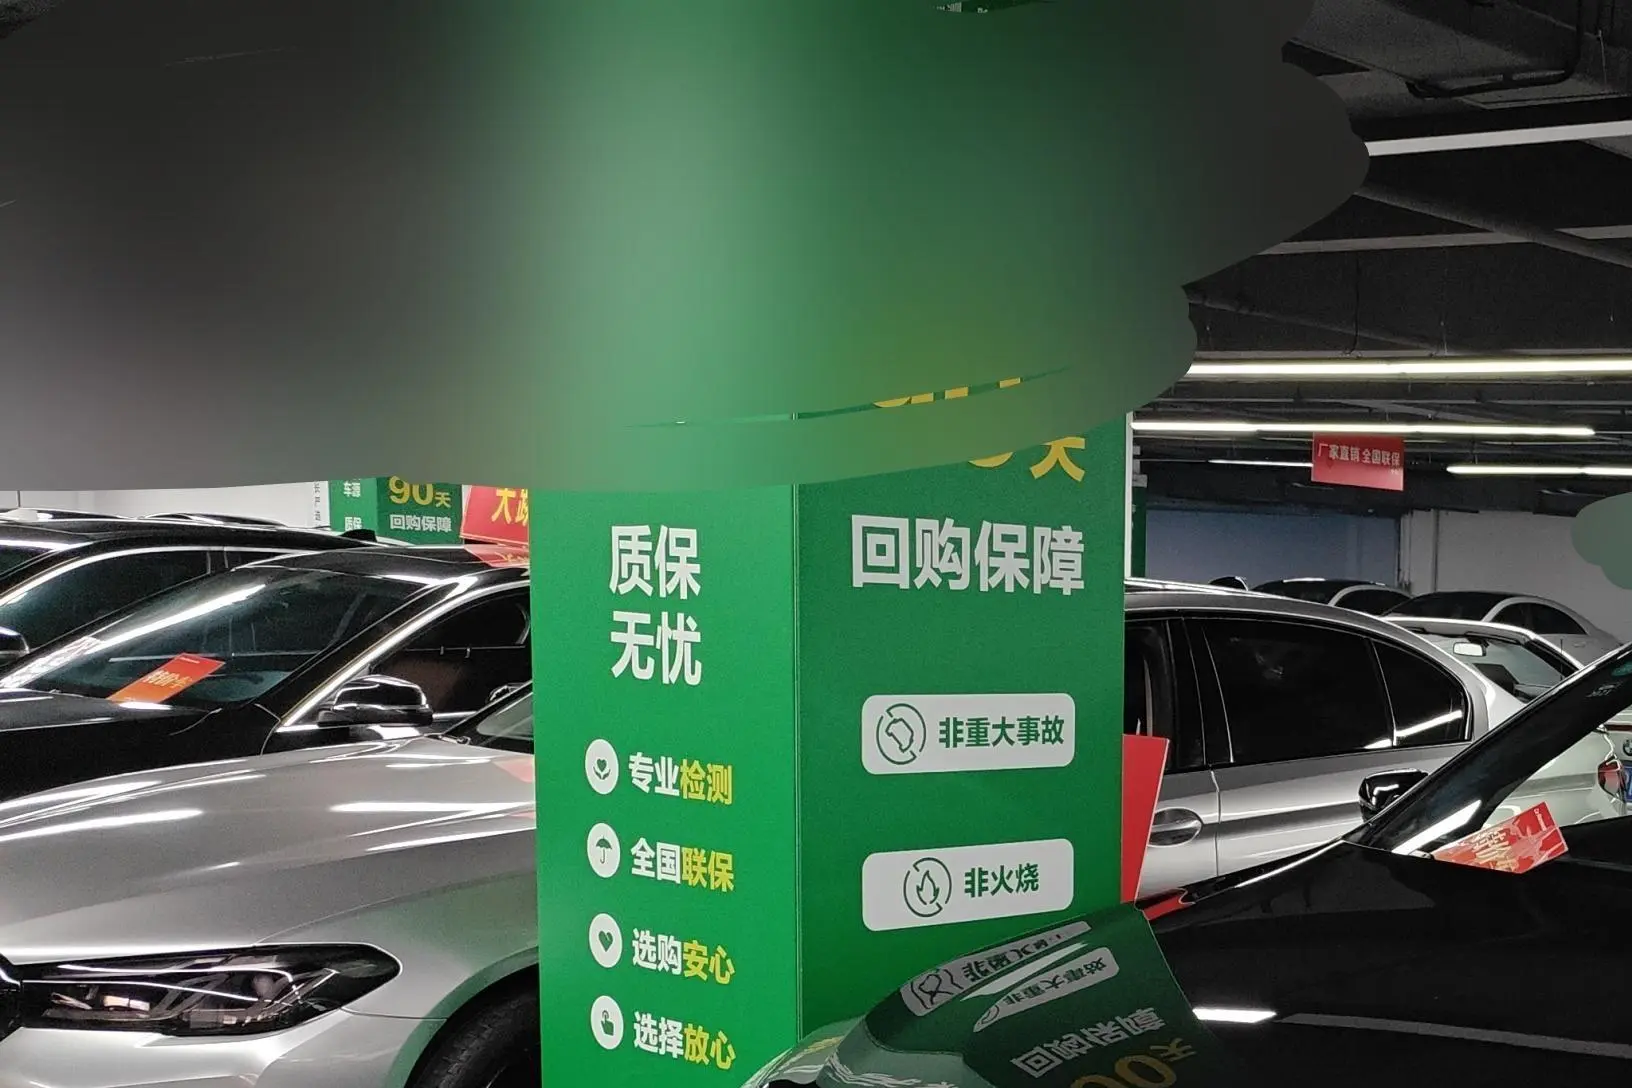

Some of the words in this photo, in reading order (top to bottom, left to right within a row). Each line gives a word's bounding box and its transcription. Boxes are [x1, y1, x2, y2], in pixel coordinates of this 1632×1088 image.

[389, 514, 451, 533] 回购保障
[609, 524, 702, 600] 质保
[852, 514, 1085, 596] 回购保障
[610, 610, 702, 685] 无忧
[938, 715, 1065, 749] 非重大事故
[628, 751, 733, 806] 专业检测
[630, 837, 735, 892] 全国联保
[963, 862, 1040, 898] 非火烧
[632, 928, 736, 985] 选购安心
[633, 1011, 737, 1070] 选择放心
